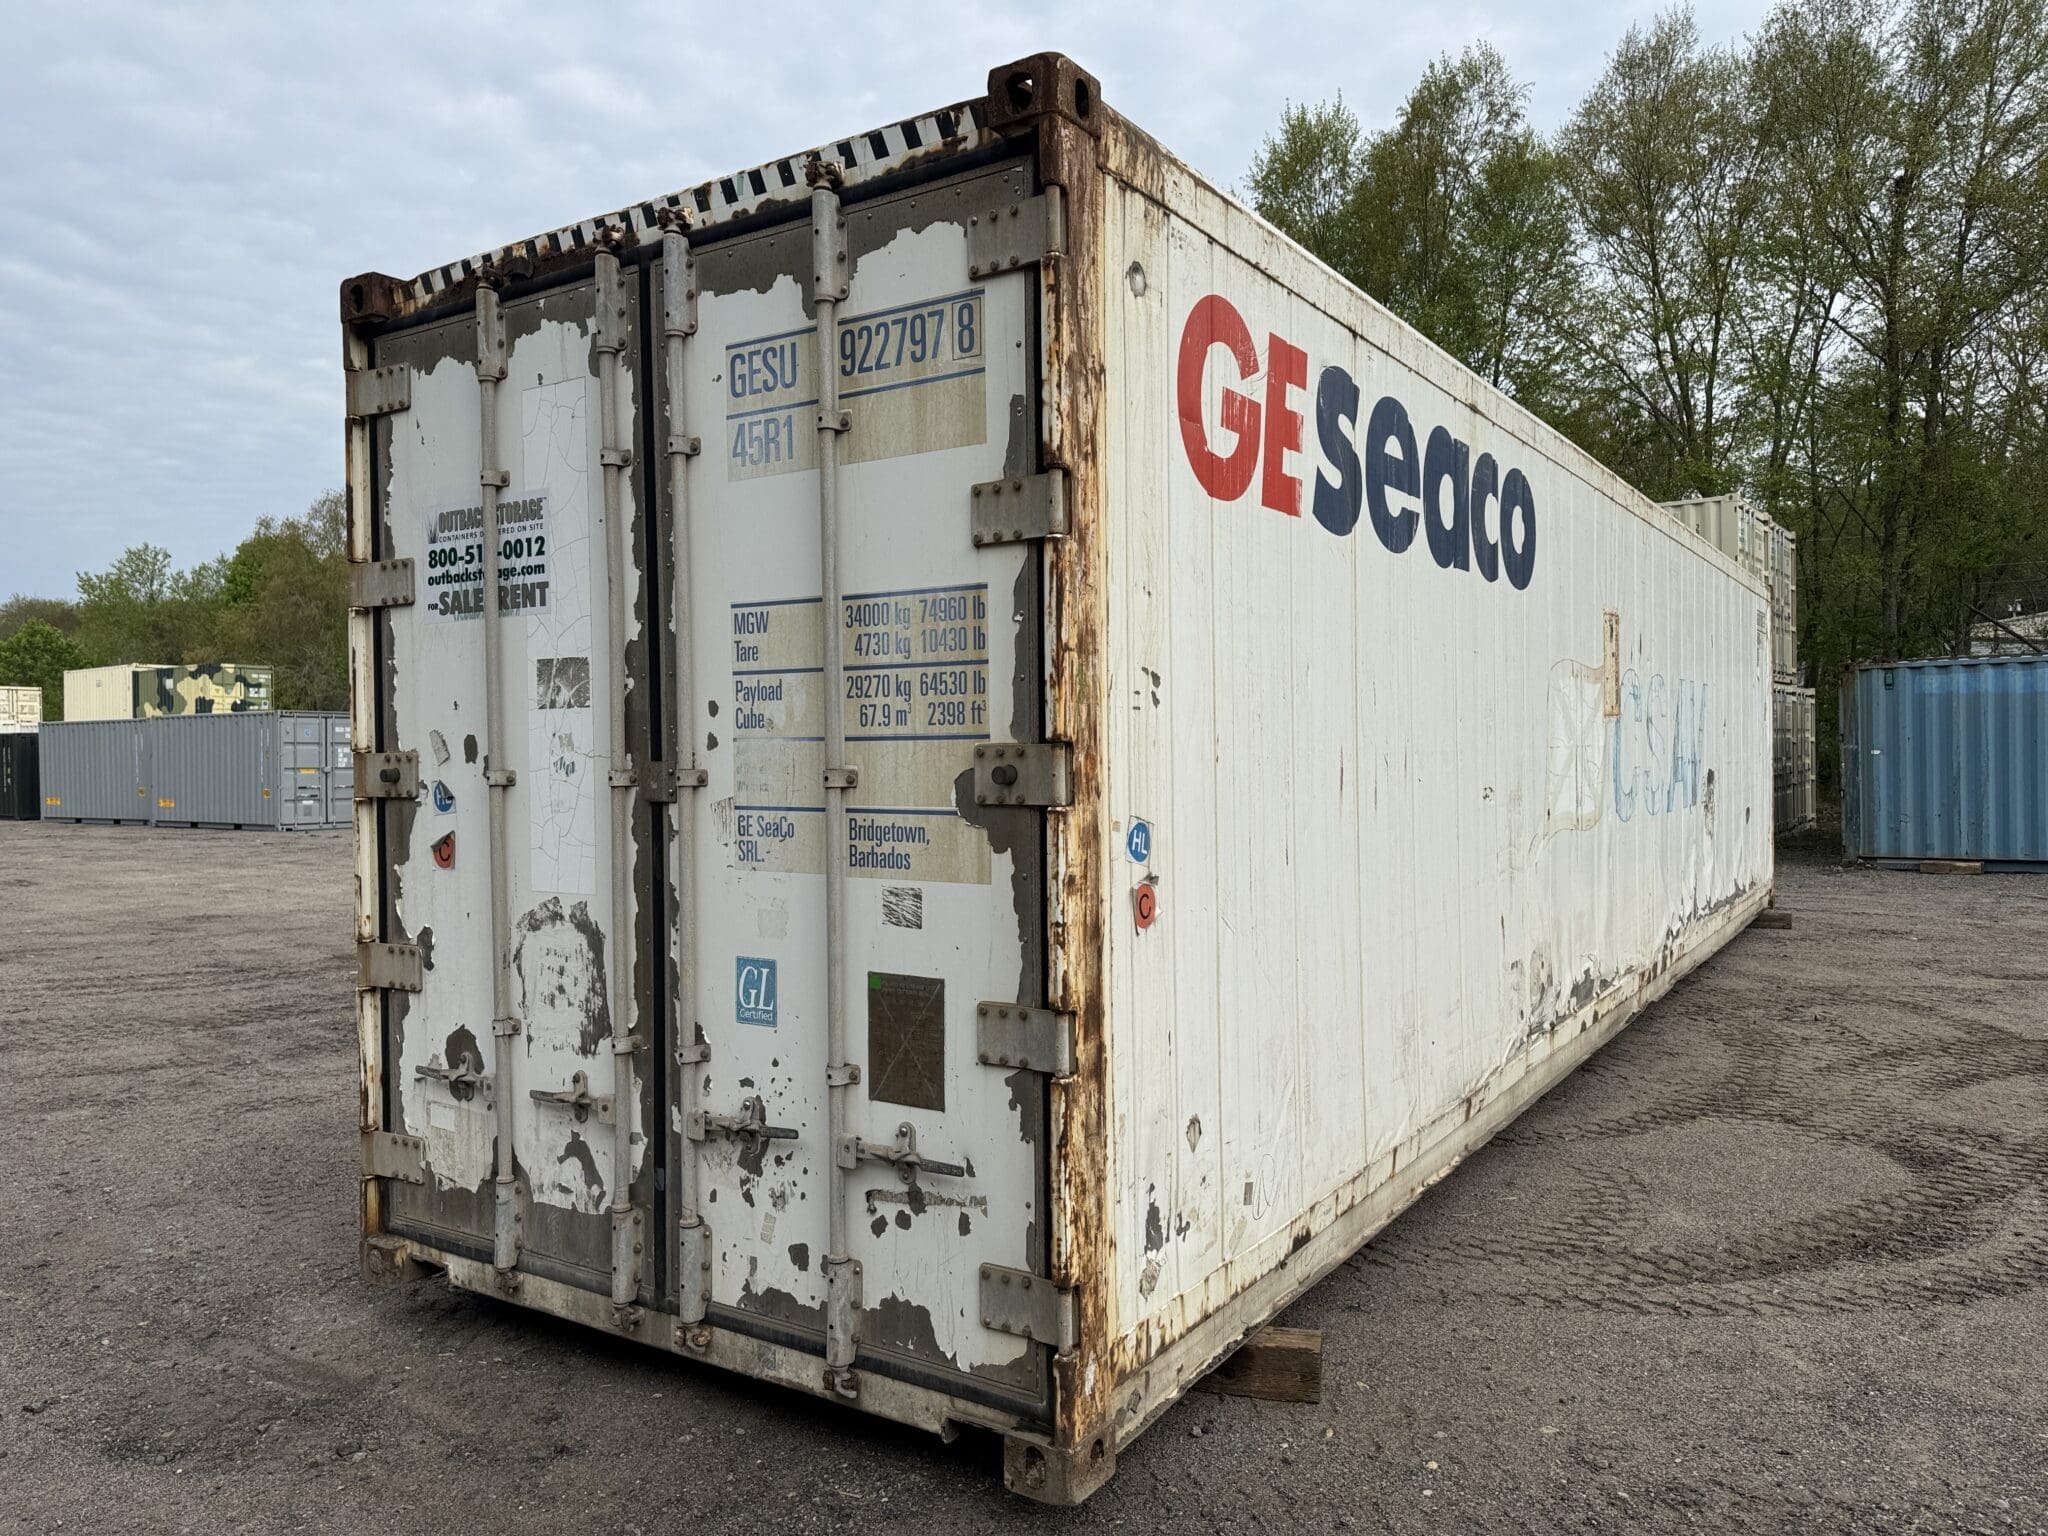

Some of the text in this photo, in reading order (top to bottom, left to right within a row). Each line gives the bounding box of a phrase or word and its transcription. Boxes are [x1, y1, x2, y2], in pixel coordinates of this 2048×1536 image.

[730, 303, 975, 398] GESU 922797 8
[732, 414, 793, 467] 45R1
[438, 531, 478, 543] CONTAINERS
[529, 523, 544, 531] SITE
[428, 536, 545, 569] 800-51-0012
[428, 603, 438, 611] FOR
[439, 587, 484, 616] SALE
[498, 581, 549, 611] RENT
[734, 595, 985, 635] MGW 34000 kg 74960 lb
[734, 626, 985, 662] Tare 4730 kg 10430 lb
[735, 670, 986, 706] Payload 29270 kg 64530 lb
[735, 707, 765, 729] Cube
[859, 703, 890, 728] 67.9
[928, 701, 965, 726] 2398
[738, 815, 930, 847] GE SeaCo Bridgetown,
[1132, 829, 1148, 855] HL
[439, 841, 451, 862] C
[738, 840, 911, 870] SRL. Barbados
[1139, 893, 1151, 919] C
[738, 965, 774, 1011] GL
[739, 1007, 773, 1022] Certified
